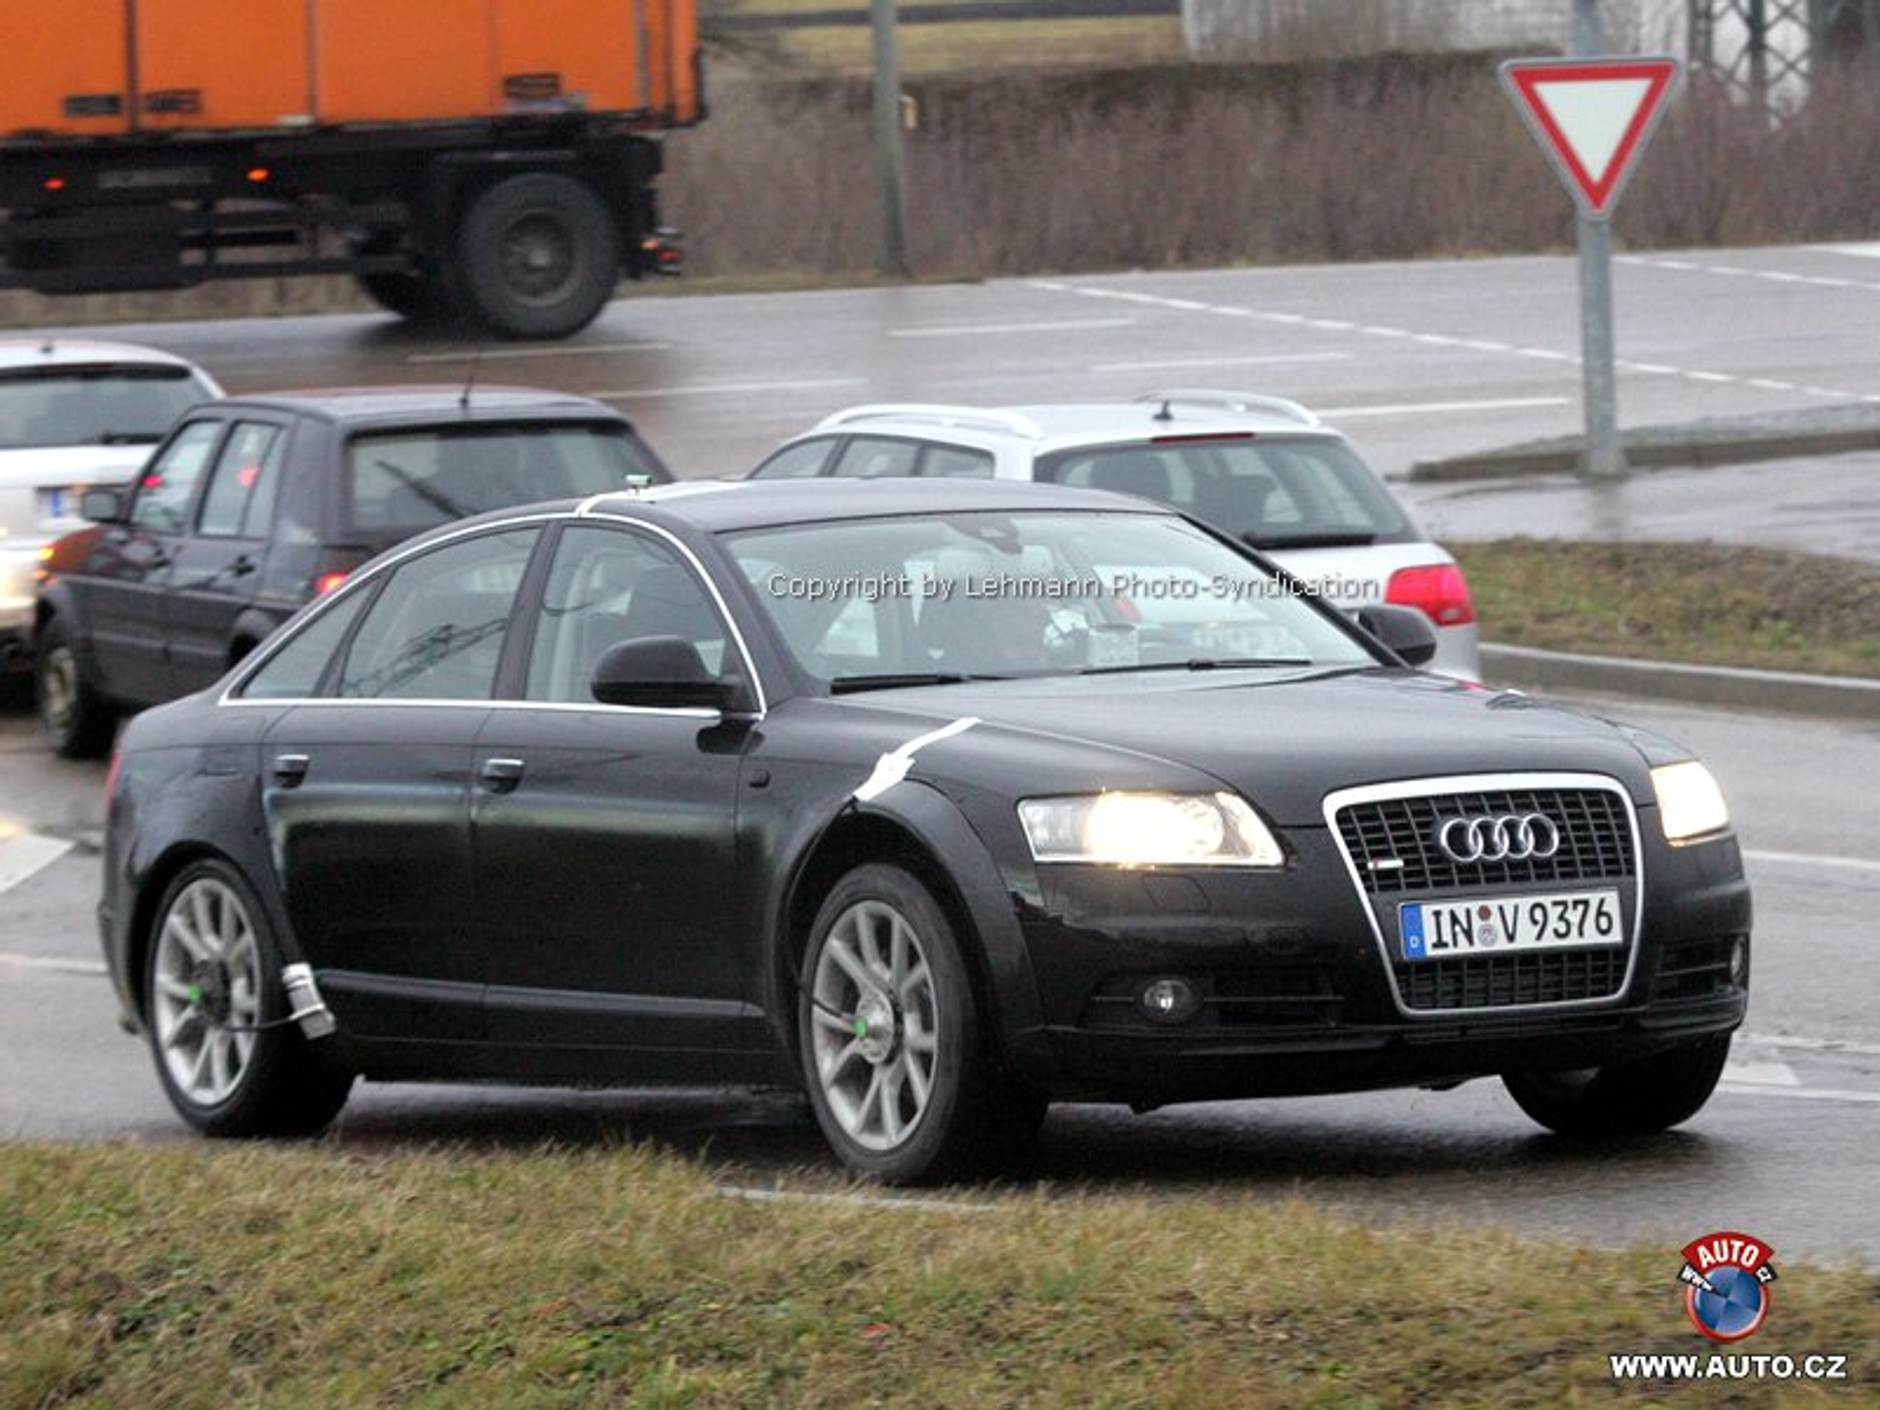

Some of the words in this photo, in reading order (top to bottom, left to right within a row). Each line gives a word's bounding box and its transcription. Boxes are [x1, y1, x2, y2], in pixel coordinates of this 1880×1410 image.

[1431, 907, 1475, 949] IN
[1498, 904, 1520, 944] V
[1529, 897, 1614, 942] 9376
